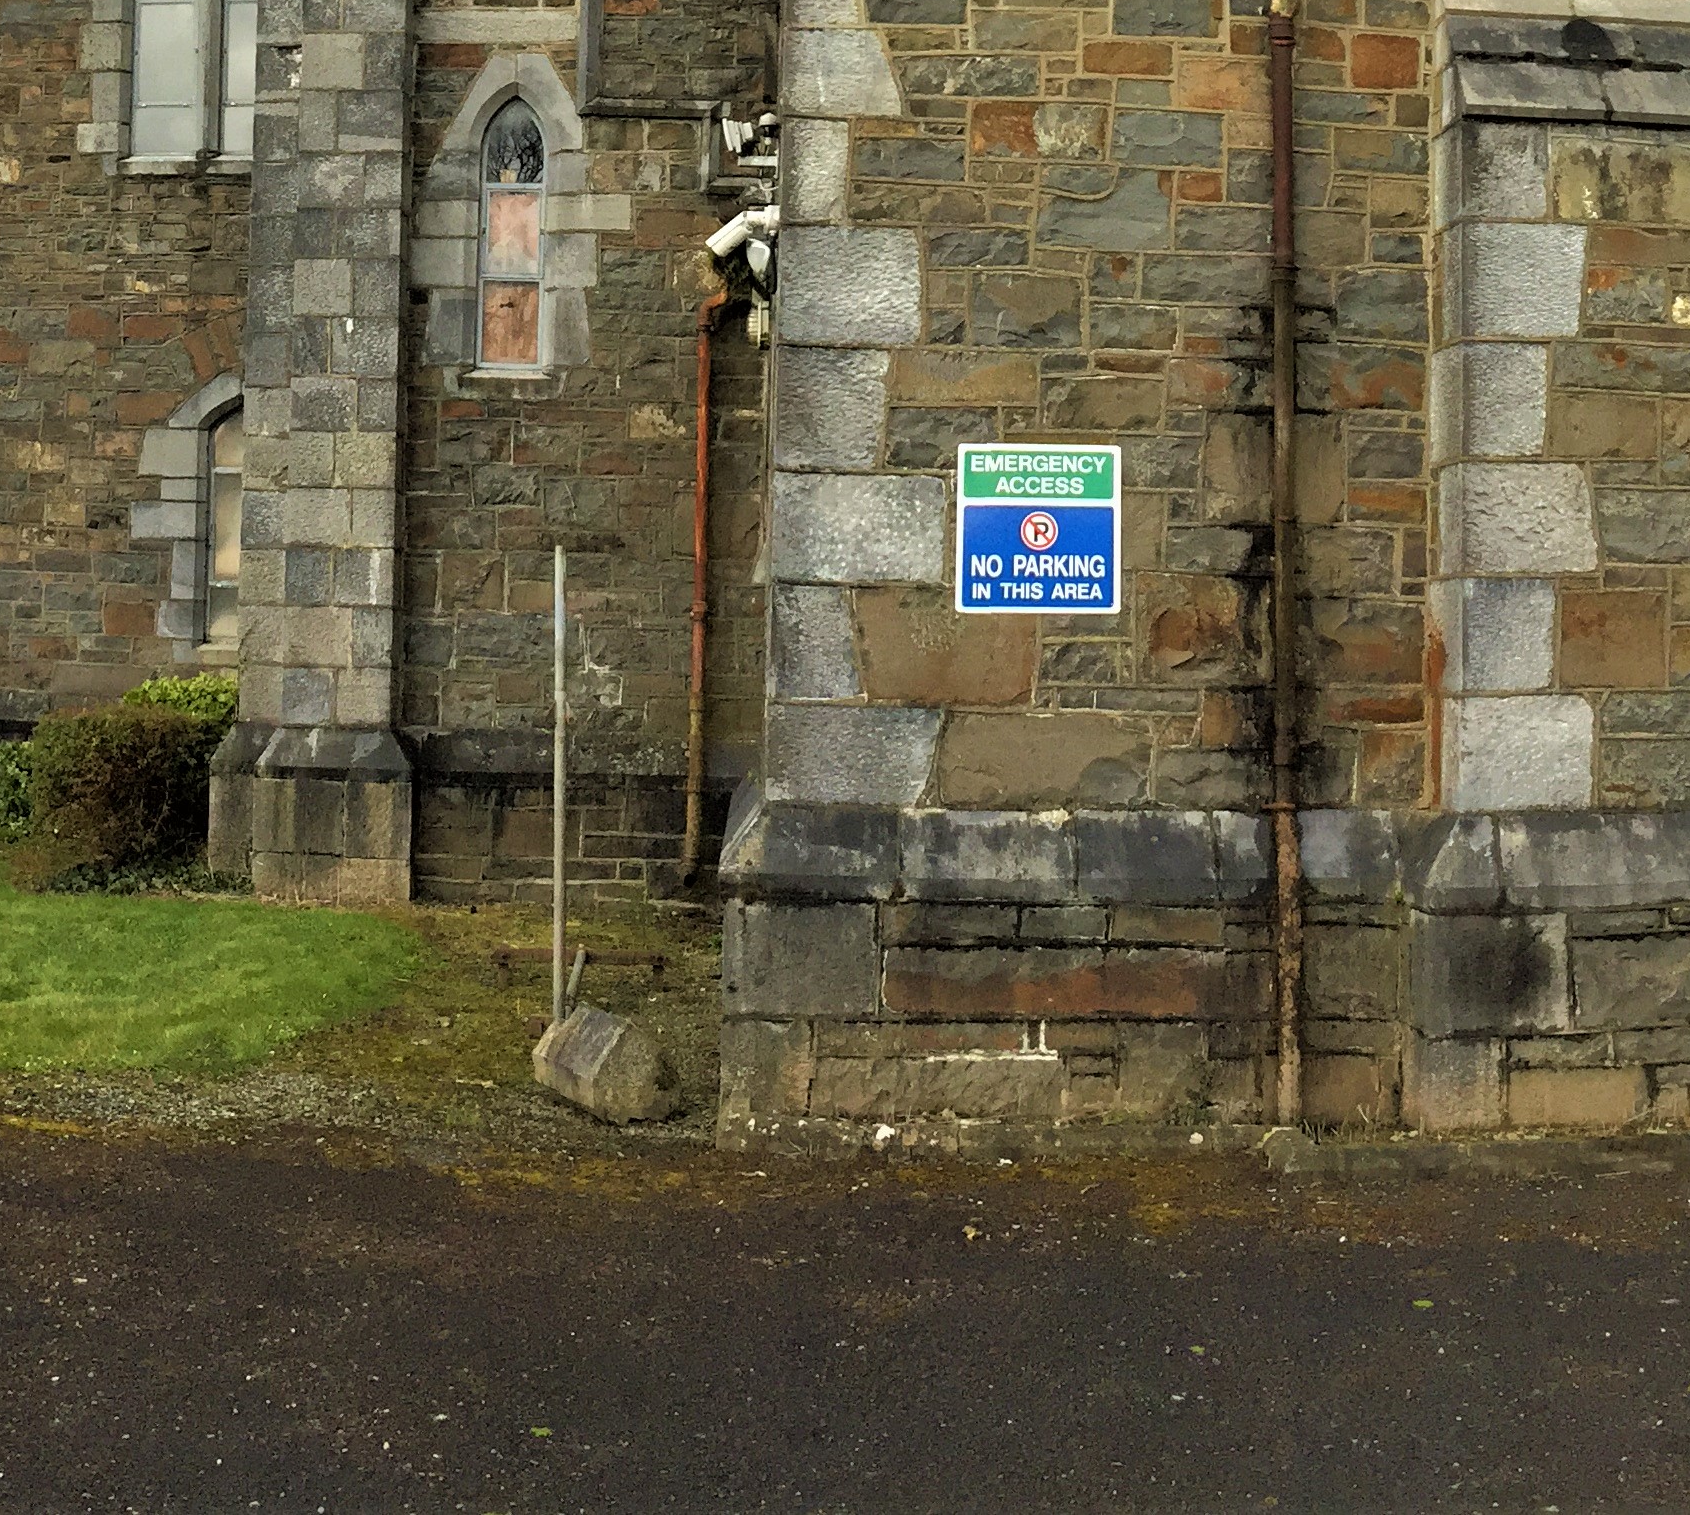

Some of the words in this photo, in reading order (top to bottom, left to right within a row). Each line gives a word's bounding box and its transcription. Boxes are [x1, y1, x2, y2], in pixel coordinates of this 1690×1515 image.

[970, 454, 1106, 473] EMERGENCY
[995, 476, 1084, 495] ACCESS
[971, 554, 1003, 578] NO
[1013, 554, 1106, 578] PARKING
[972, 583, 991, 600] IN
[1000, 582, 1044, 600] THIS
[1051, 583, 1103, 600] AREA
